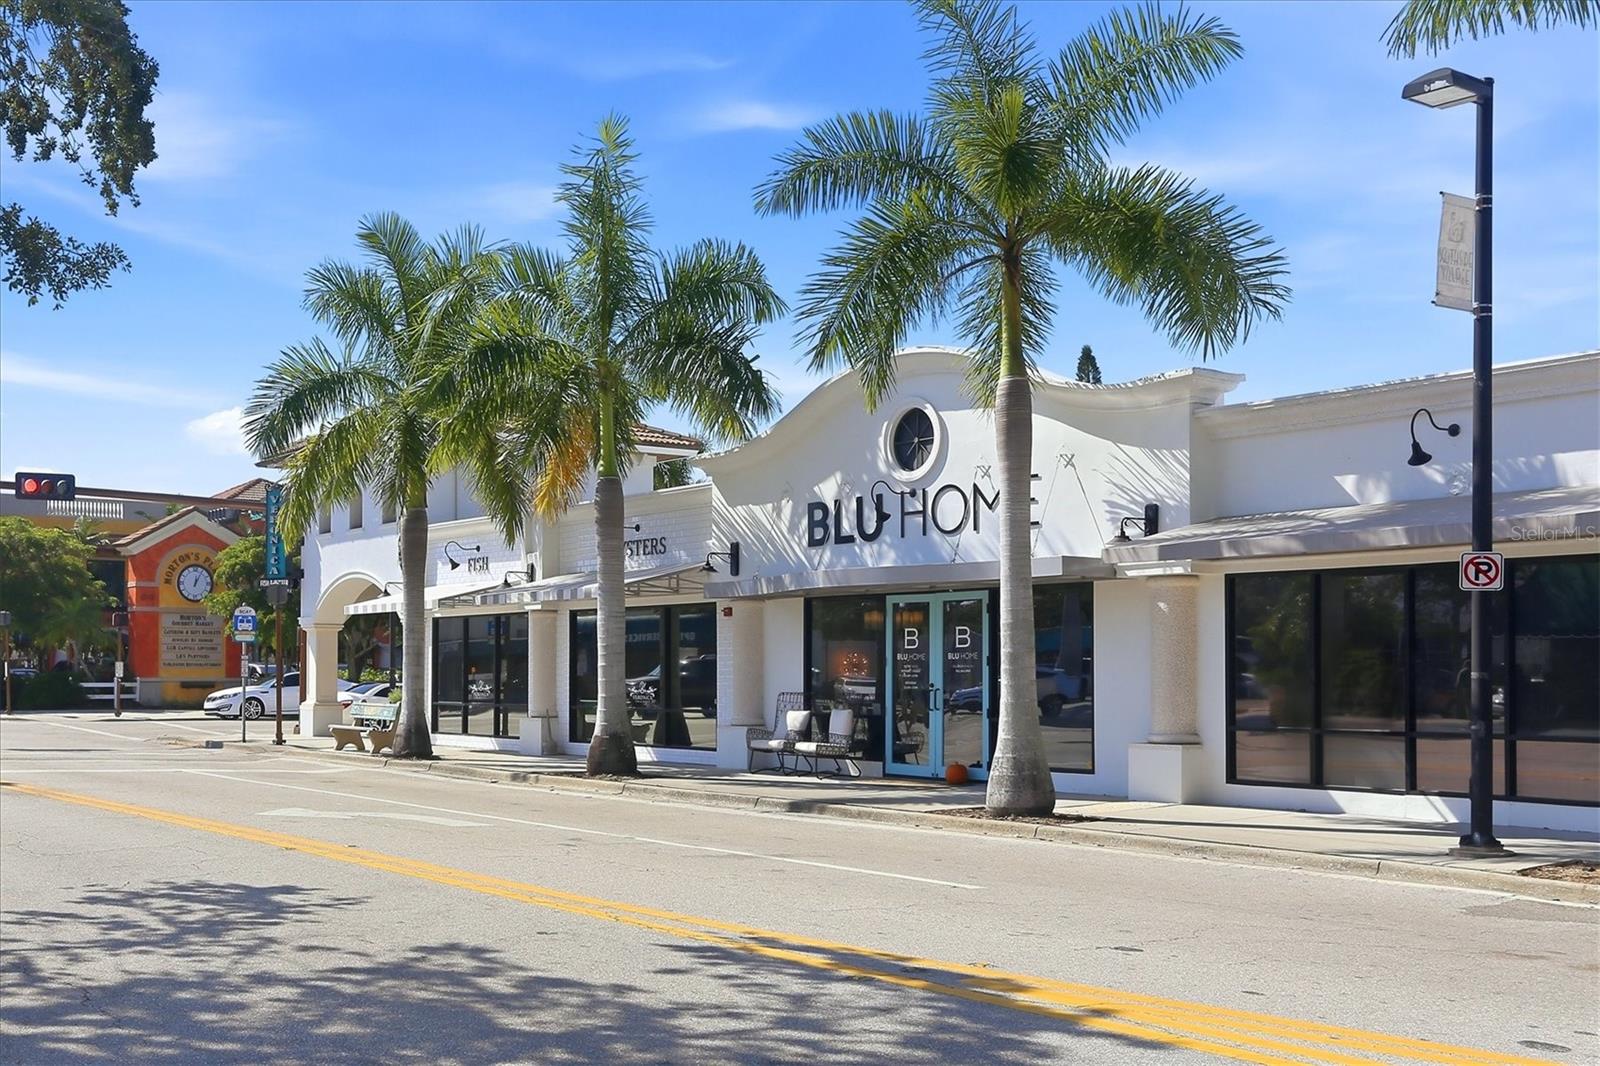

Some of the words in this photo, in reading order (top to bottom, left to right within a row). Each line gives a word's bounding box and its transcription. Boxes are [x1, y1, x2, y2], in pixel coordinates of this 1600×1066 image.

[807, 493, 884, 548] BLU
[901, 474, 1039, 538] HOM
[623, 536, 667, 558] STERS
[163, 552, 201, 586] MORTON'S
[467, 556, 489, 573] FISH
[904, 627, 919, 649] B
[955, 626, 971, 648] B
[896, 653, 909, 661] BLU
[909, 652, 927, 661] HOME
[947, 652, 960, 660] BLU
[960, 651, 979, 660] HOME
